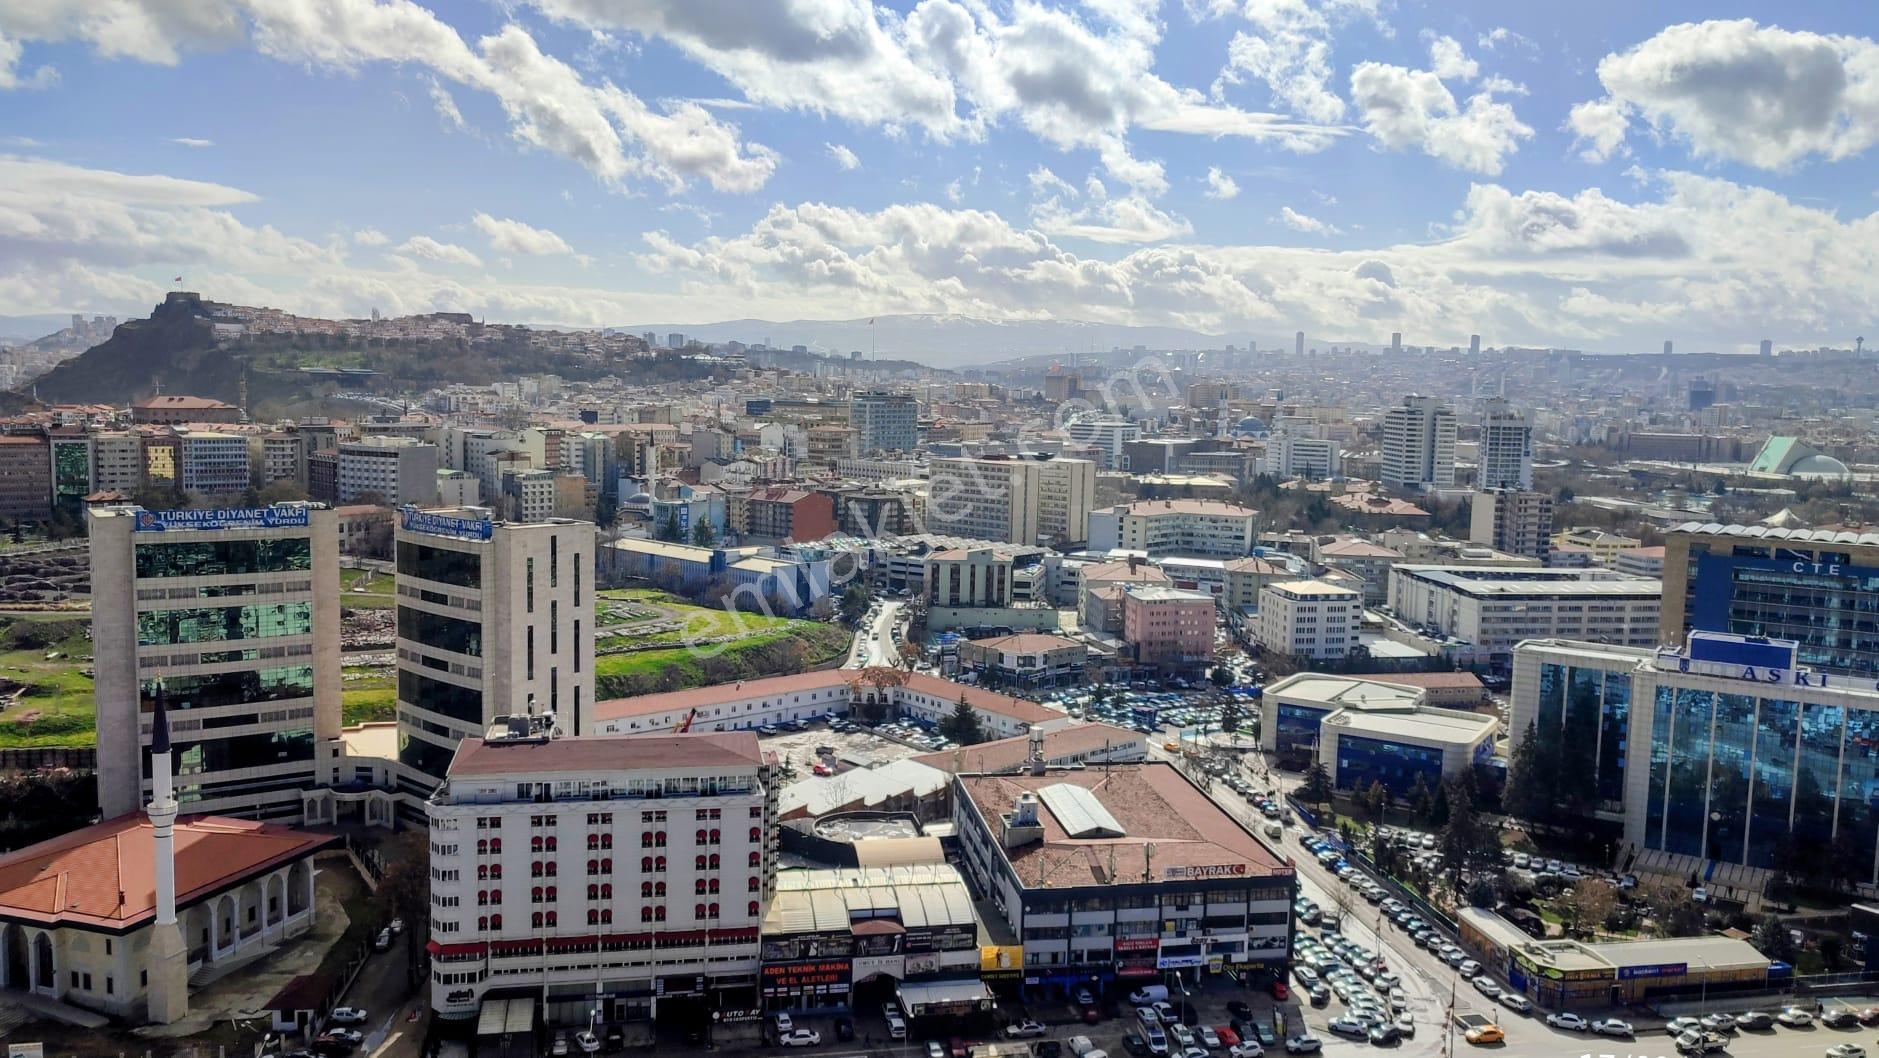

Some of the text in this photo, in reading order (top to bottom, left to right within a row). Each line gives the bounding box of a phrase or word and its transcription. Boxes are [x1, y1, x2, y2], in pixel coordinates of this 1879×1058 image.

[159, 507, 306, 521] TÜRKİYE DİYANET VAKFI
[1792, 561, 1841, 576] CTE
[1186, 865, 1231, 877] BAYRAK
[763, 966, 785, 975] ADEN
[776, 977, 787, 985] VE
